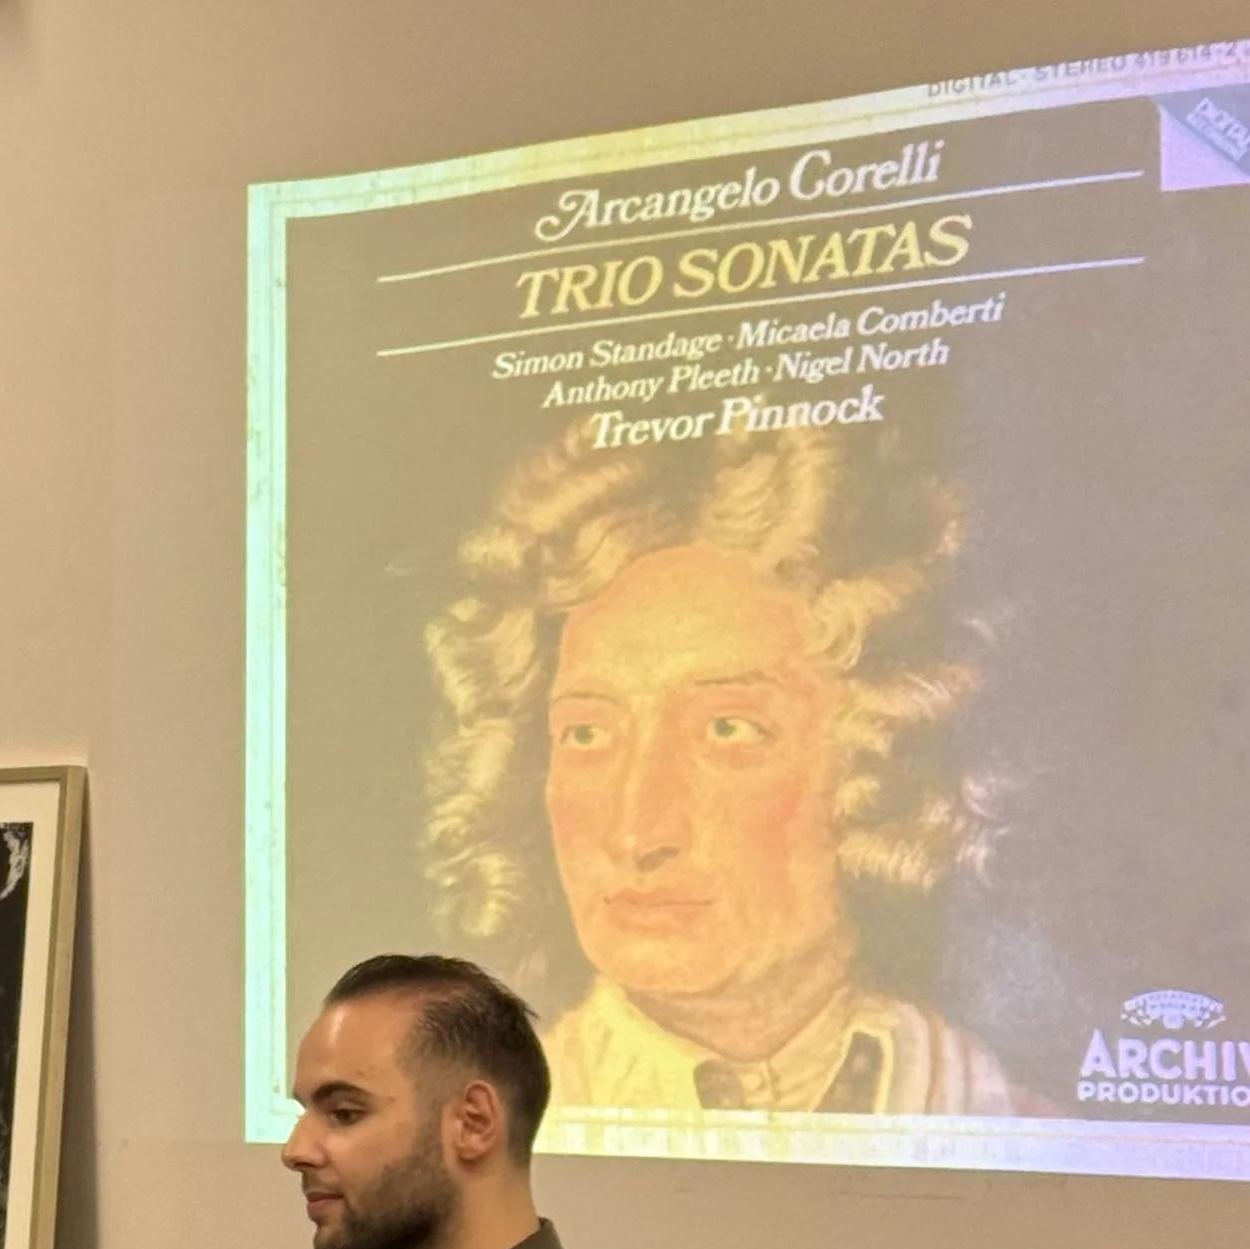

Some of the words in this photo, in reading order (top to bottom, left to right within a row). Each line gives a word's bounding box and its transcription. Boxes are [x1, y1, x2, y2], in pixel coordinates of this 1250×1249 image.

[535, 167, 780, 241] Arcangelo
[790, 140, 945, 200] Corelli
[516, 255, 663, 319] TRIO
[673, 214, 973, 298] SONATAS
[492, 350, 584, 379] Simon
[590, 332, 723, 368] Standage
[736, 312, 851, 349] Micaela
[857, 292, 1006, 335] Comberti
[541, 376, 664, 409] Anthony
[667, 357, 760, 394] Pleeth
[773, 346, 853, 383] Nigel
[857, 338, 950, 373] North
[589, 410, 715, 450] Trevor
[715, 384, 885, 435] Pinnock
[1077, 1080, 1250, 1107] PRODUKTIO
